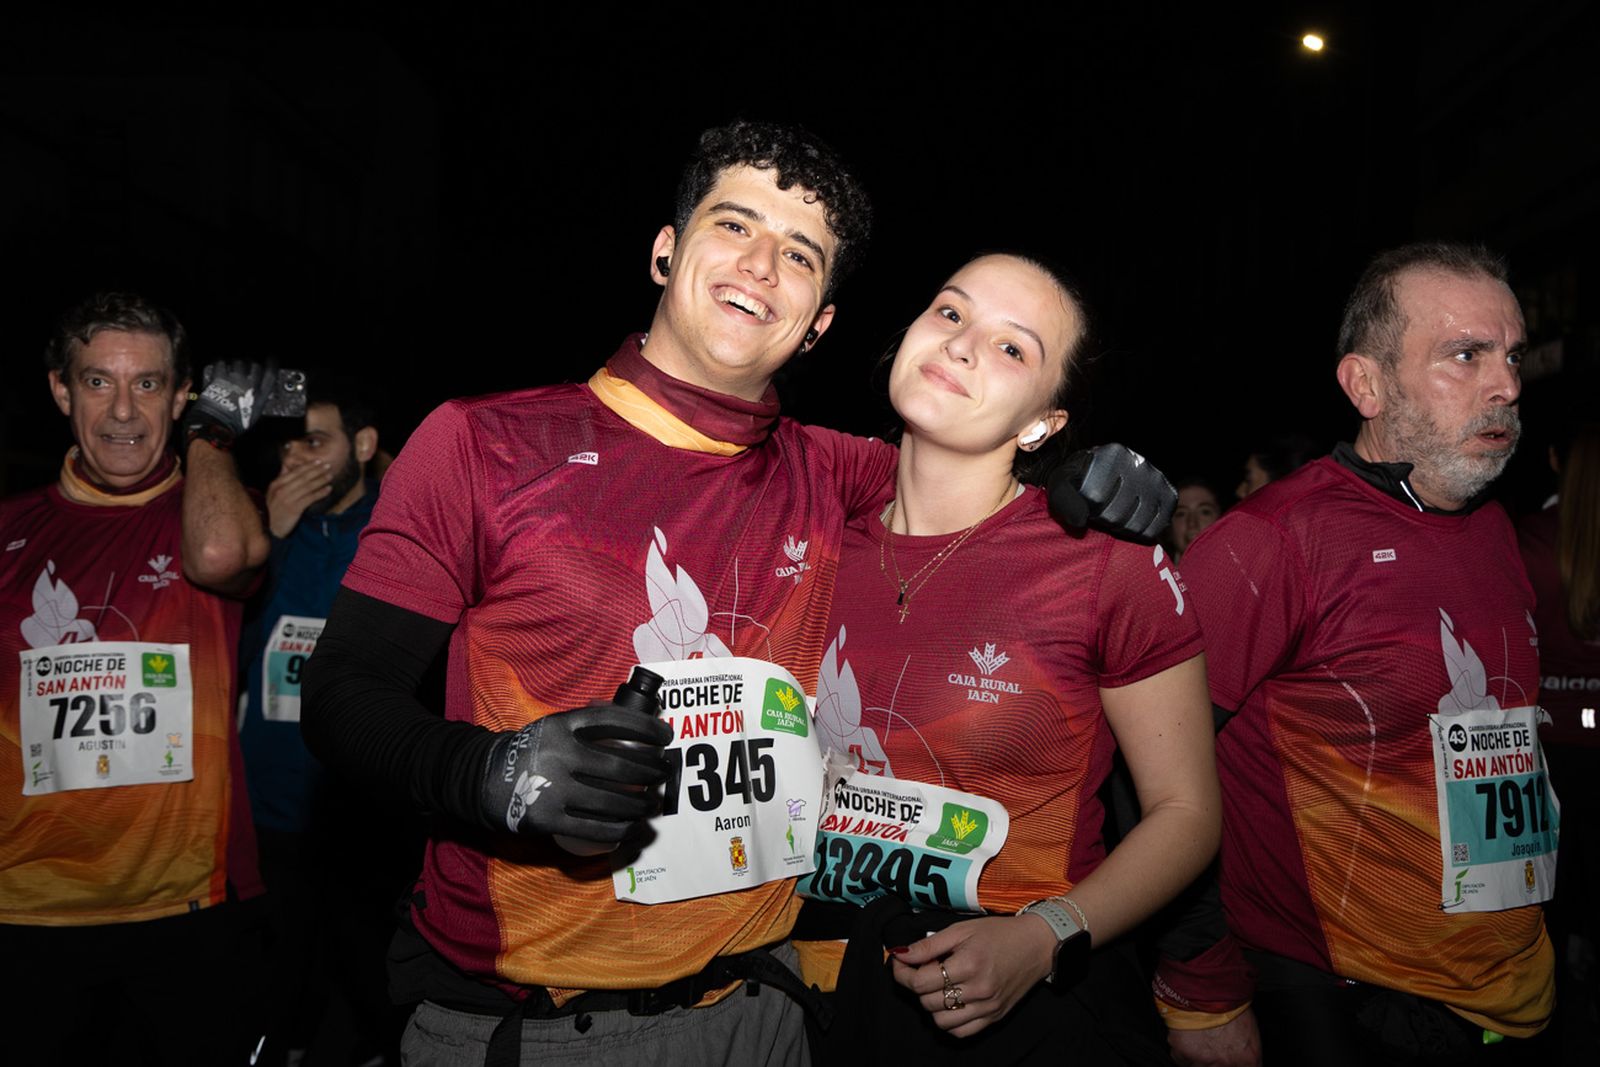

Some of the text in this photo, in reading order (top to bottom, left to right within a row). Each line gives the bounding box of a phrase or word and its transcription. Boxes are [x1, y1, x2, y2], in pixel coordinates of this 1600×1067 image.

[1375, 551, 1395, 560] 42K
[54, 658, 126, 675] NOCHE DE
[36, 677, 66, 696] SAN
[69, 672, 126, 693] ANTÓN
[680, 676, 703, 686] URBANA
[979, 678, 1023, 694] RURAL
[723, 684, 743, 704] DE
[49, 692, 157, 740] 7256
[680, 705, 745, 739] ANTÓN
[1450, 730, 1466, 745] 43
[1471, 729, 1530, 751] NOCHE DE
[1453, 748, 1534, 779] SAN ANTÓN
[662, 738, 776, 816] 7345
[837, 791, 896, 819] NOCHE
[900, 804, 923, 824] DE
[1476, 775, 1550, 839] 7912
[715, 815, 751, 832] Aaron
